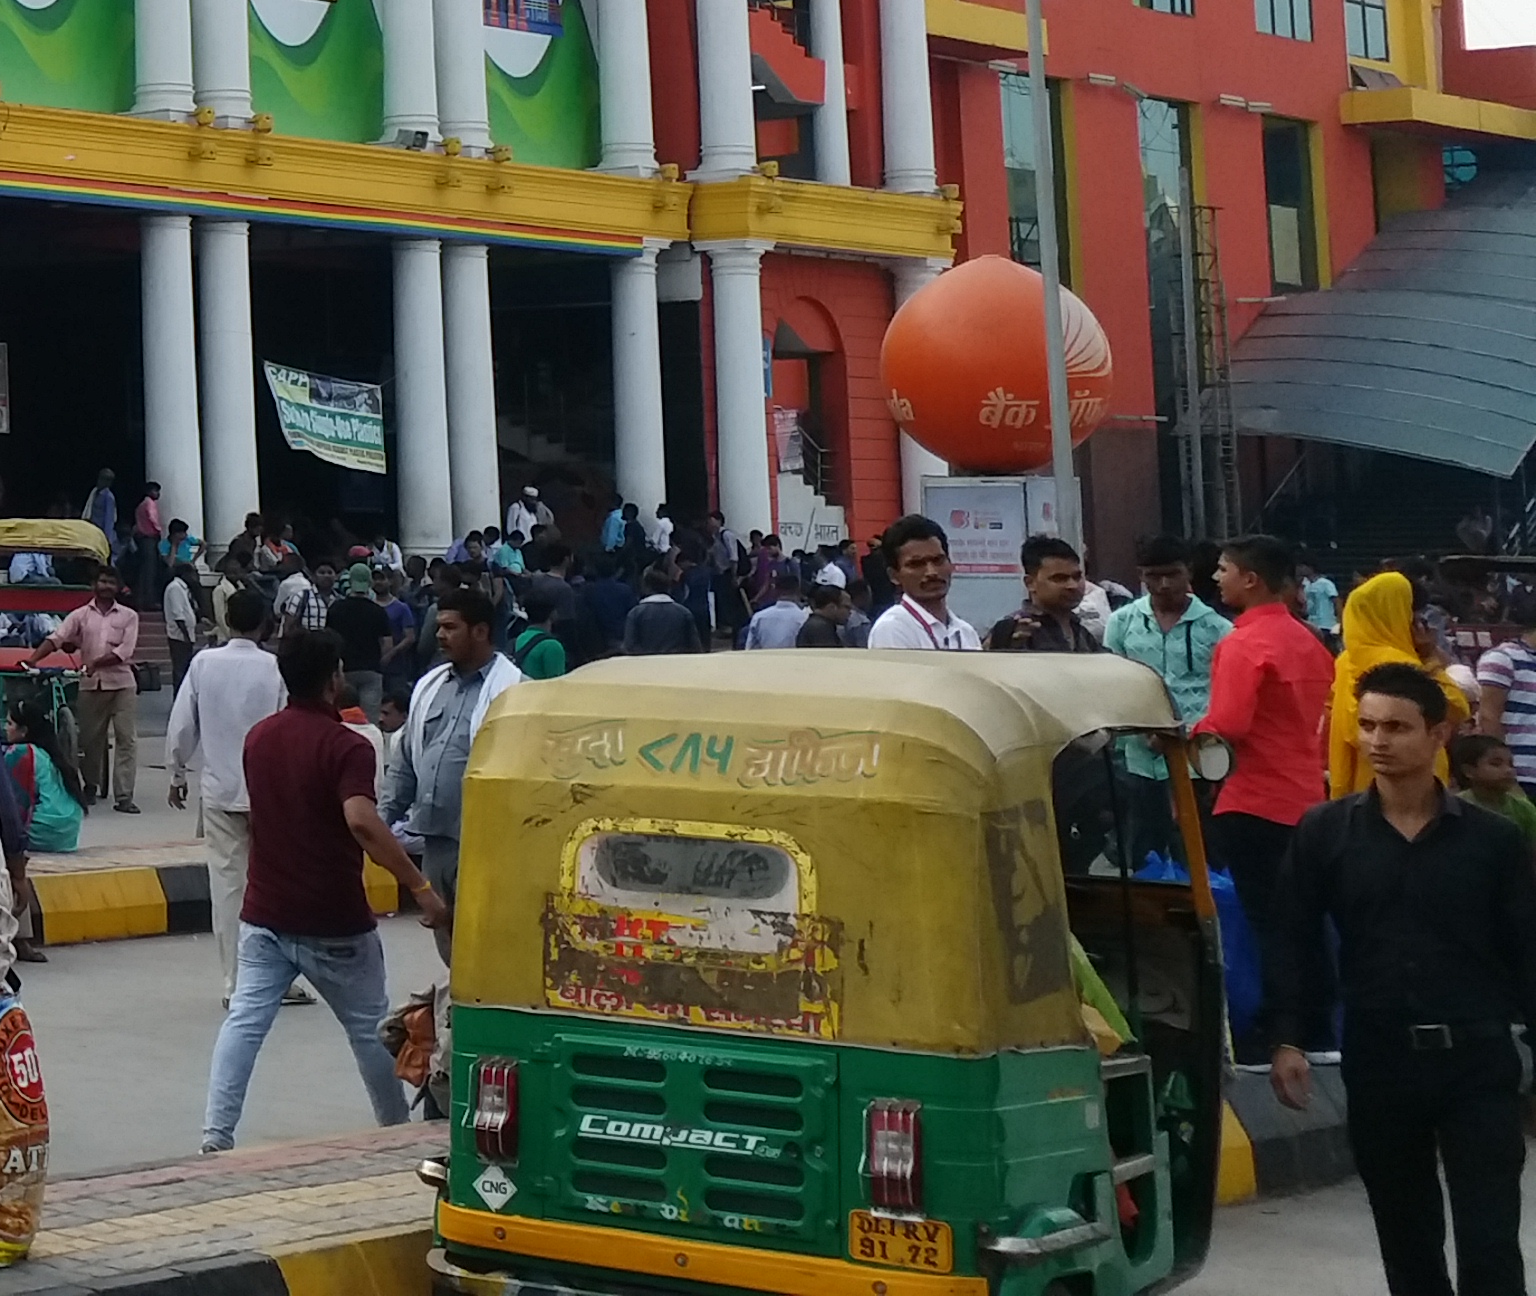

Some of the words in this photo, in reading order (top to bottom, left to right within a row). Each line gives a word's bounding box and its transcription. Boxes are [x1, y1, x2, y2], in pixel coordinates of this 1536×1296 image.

[979, 386, 1040, 429] बैंक
[10, 1047, 39, 1088] 50
[481, 1179, 508, 1197] CNG
